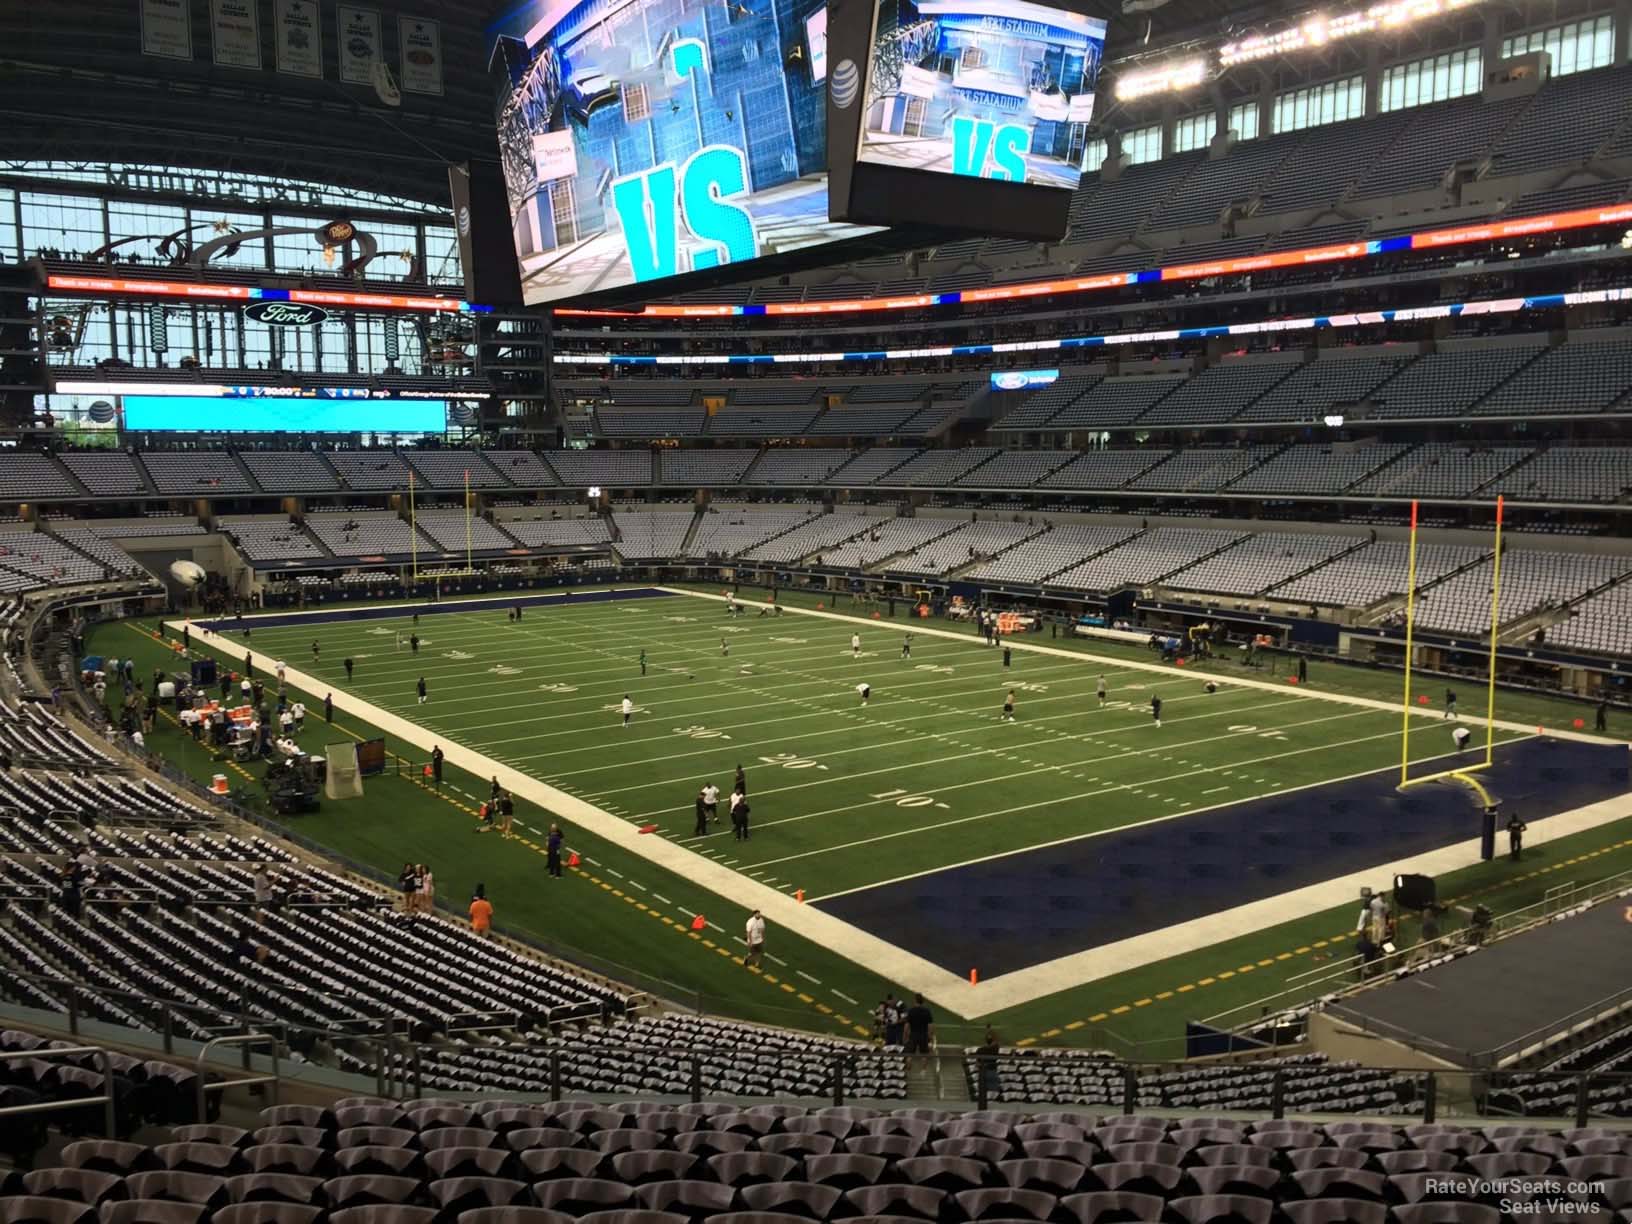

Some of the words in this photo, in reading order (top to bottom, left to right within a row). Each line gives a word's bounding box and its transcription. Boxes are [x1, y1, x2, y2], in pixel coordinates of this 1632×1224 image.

[1006, 18, 1049, 37] STADIUM
[951, 116, 1031, 183] VS
[612, 143, 759, 284] VS
[259, 304, 313, 323] Ford
[757, 752, 817, 769] 20
[868, 788, 935, 808] 10
